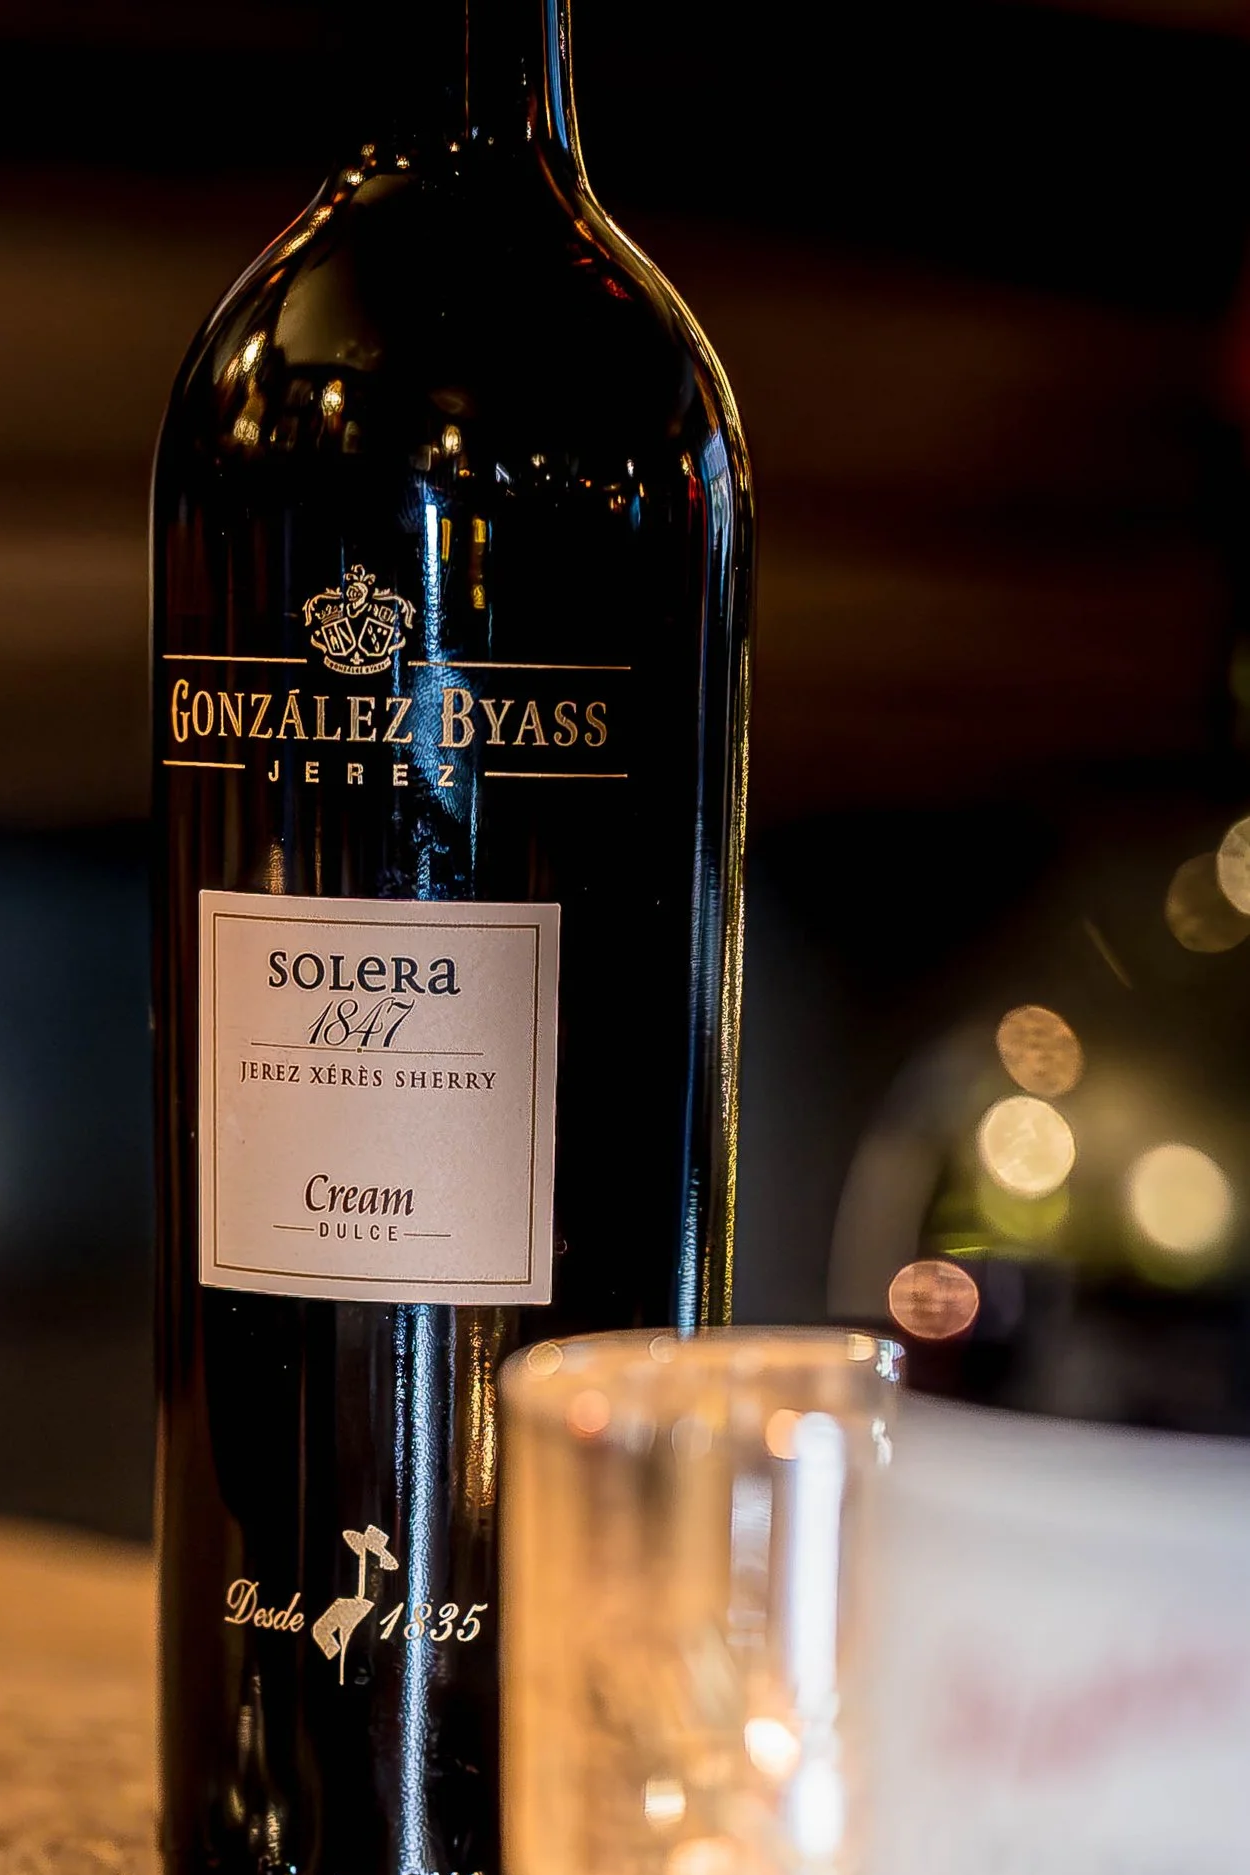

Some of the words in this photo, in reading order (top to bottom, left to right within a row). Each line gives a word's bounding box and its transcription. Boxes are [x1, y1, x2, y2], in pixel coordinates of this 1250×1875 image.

[171, 677, 413, 743] GONZÁLEZ
[438, 687, 608, 749] BYASS
[268, 761, 454, 787] JEREZ
[306, 996, 415, 1048] 1847
[240, 1061, 301, 1083] JEREZ
[310, 1064, 383, 1087] XÉRÈS
[395, 1070, 497, 1090] SHERRY
[304, 1174, 414, 1216] Cream
[319, 1222, 398, 1241] DULCE
[224, 1578, 305, 1632] Desde
[378, 1602, 489, 1642] 1835
